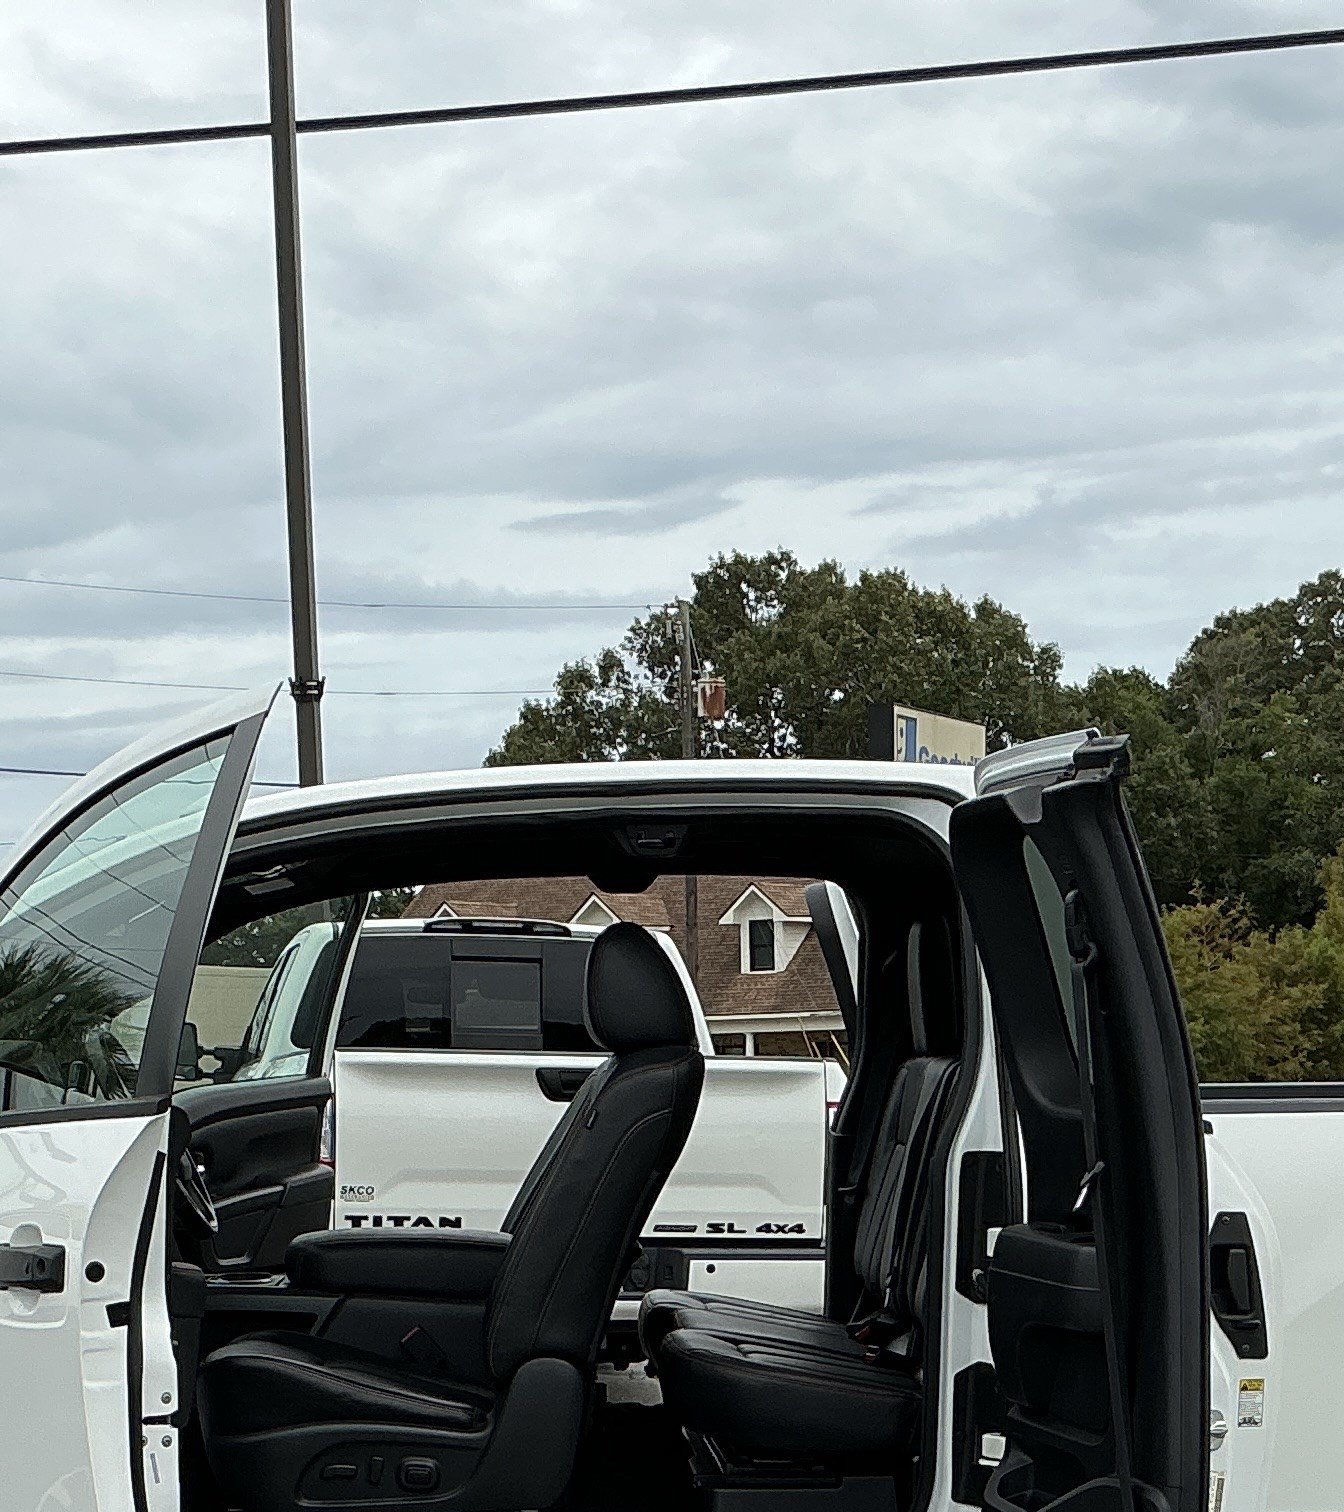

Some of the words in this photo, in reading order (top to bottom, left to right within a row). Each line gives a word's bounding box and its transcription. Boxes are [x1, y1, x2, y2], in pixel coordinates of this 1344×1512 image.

[340, 1185, 374, 1196] SKCO
[344, 1215, 462, 1228] TITAN
[706, 1223, 747, 1234] SL
